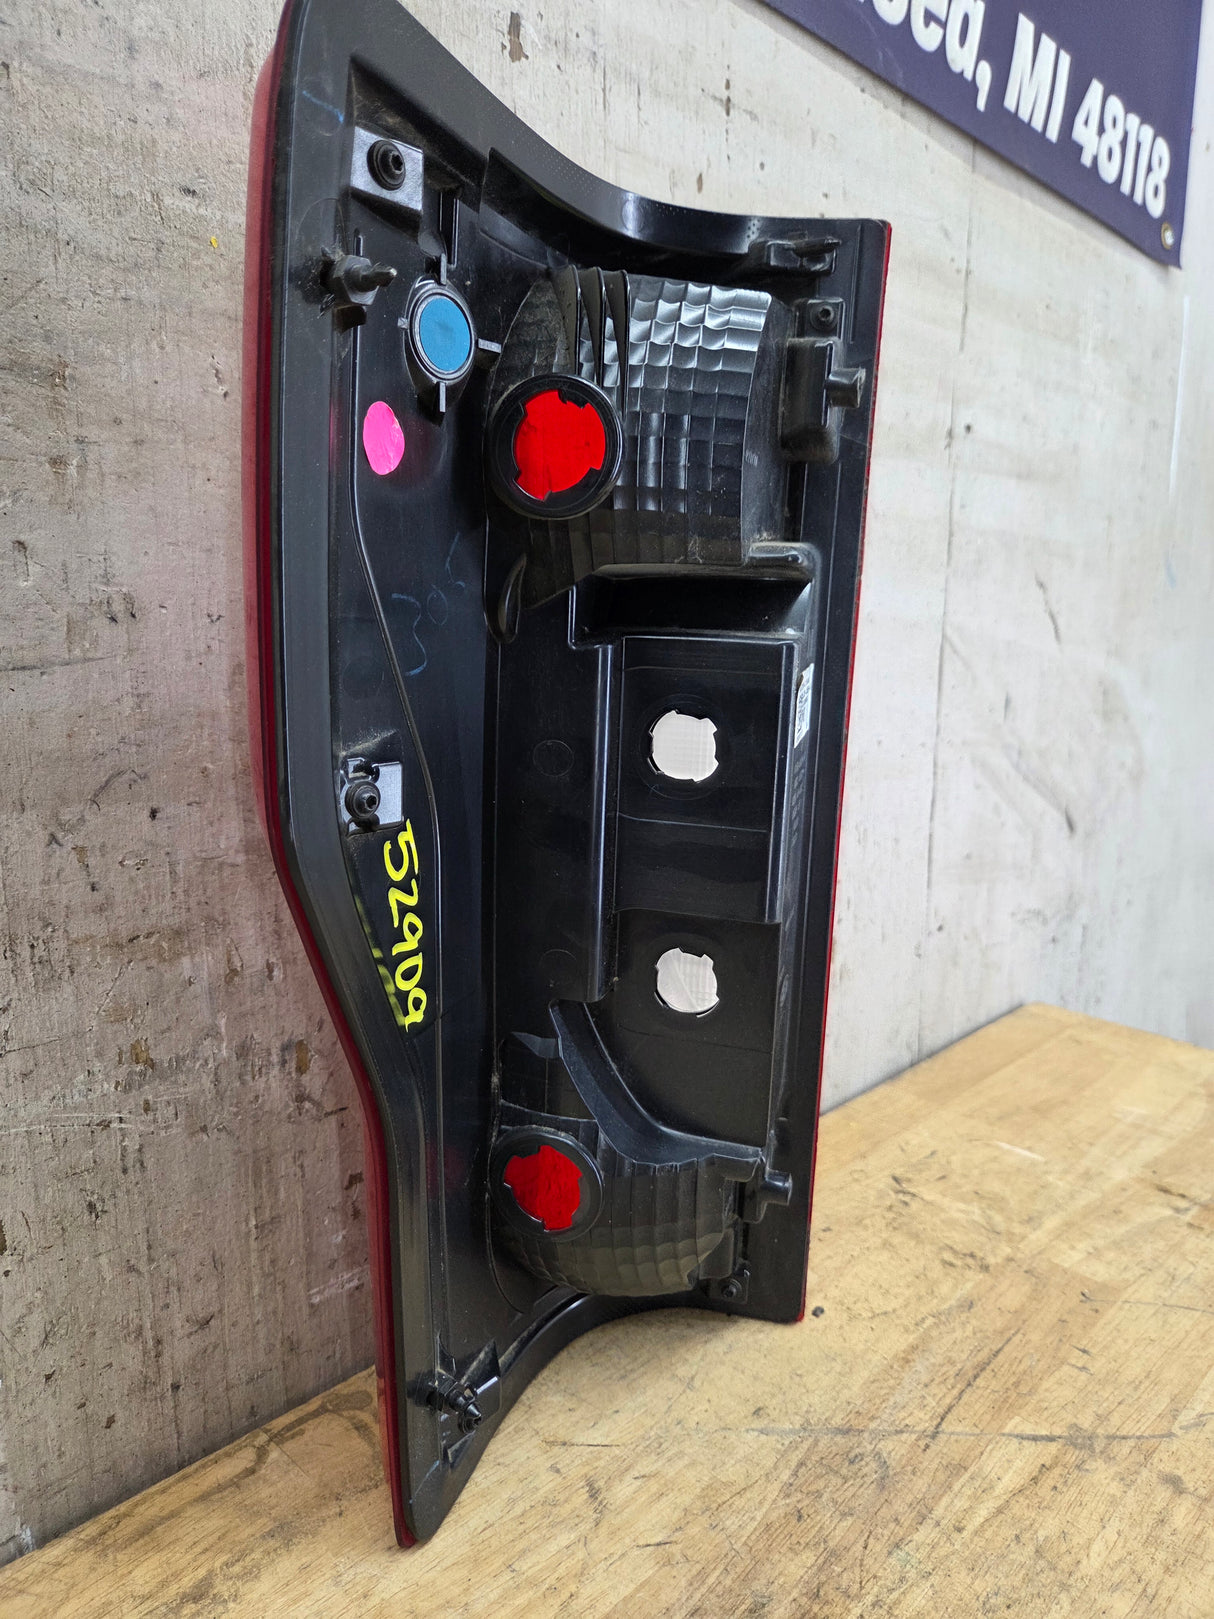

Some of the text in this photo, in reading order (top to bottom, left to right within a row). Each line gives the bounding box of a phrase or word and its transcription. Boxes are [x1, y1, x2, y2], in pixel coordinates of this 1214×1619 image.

[1003, 12, 1071, 144] MI
[1071, 78, 1170, 219] 48118
[383, 818, 427, 1032] 52909
